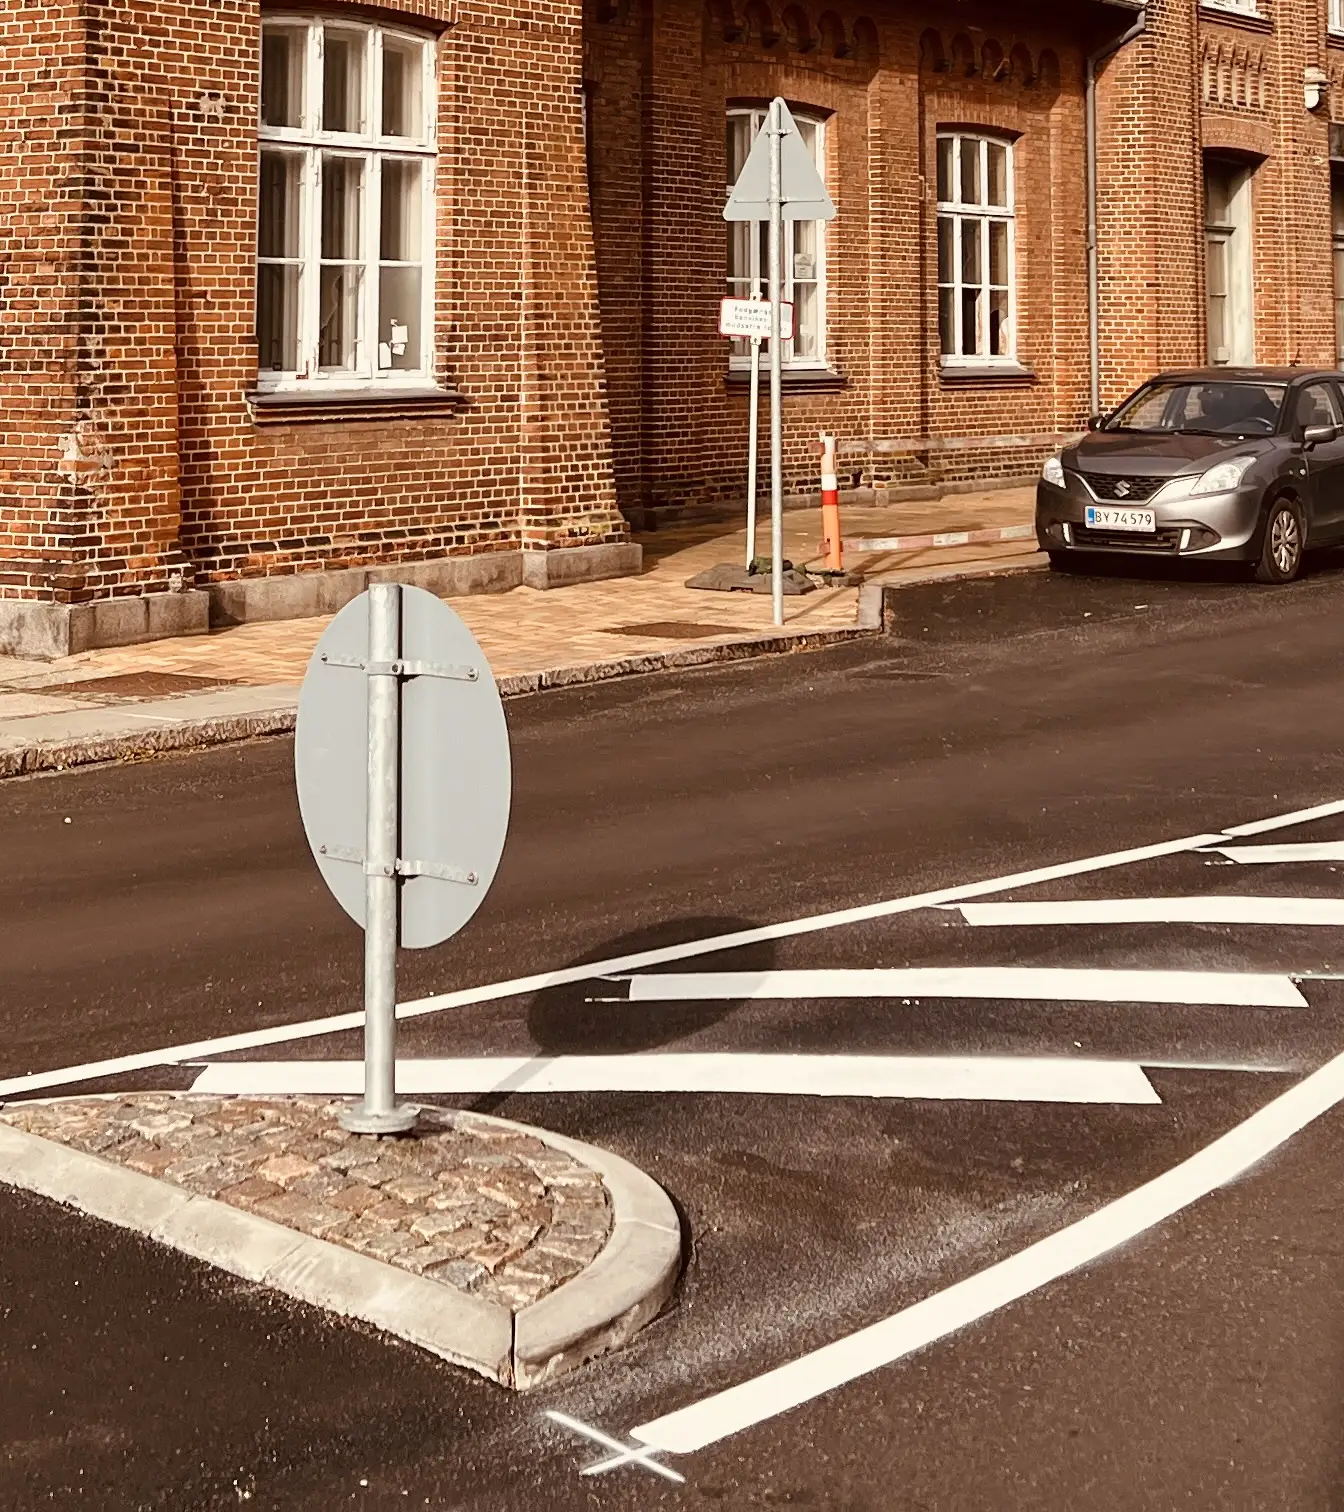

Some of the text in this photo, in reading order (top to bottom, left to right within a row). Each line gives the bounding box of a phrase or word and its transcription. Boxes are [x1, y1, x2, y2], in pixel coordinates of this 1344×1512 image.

[1095, 511, 1152, 525] BY 74 579
